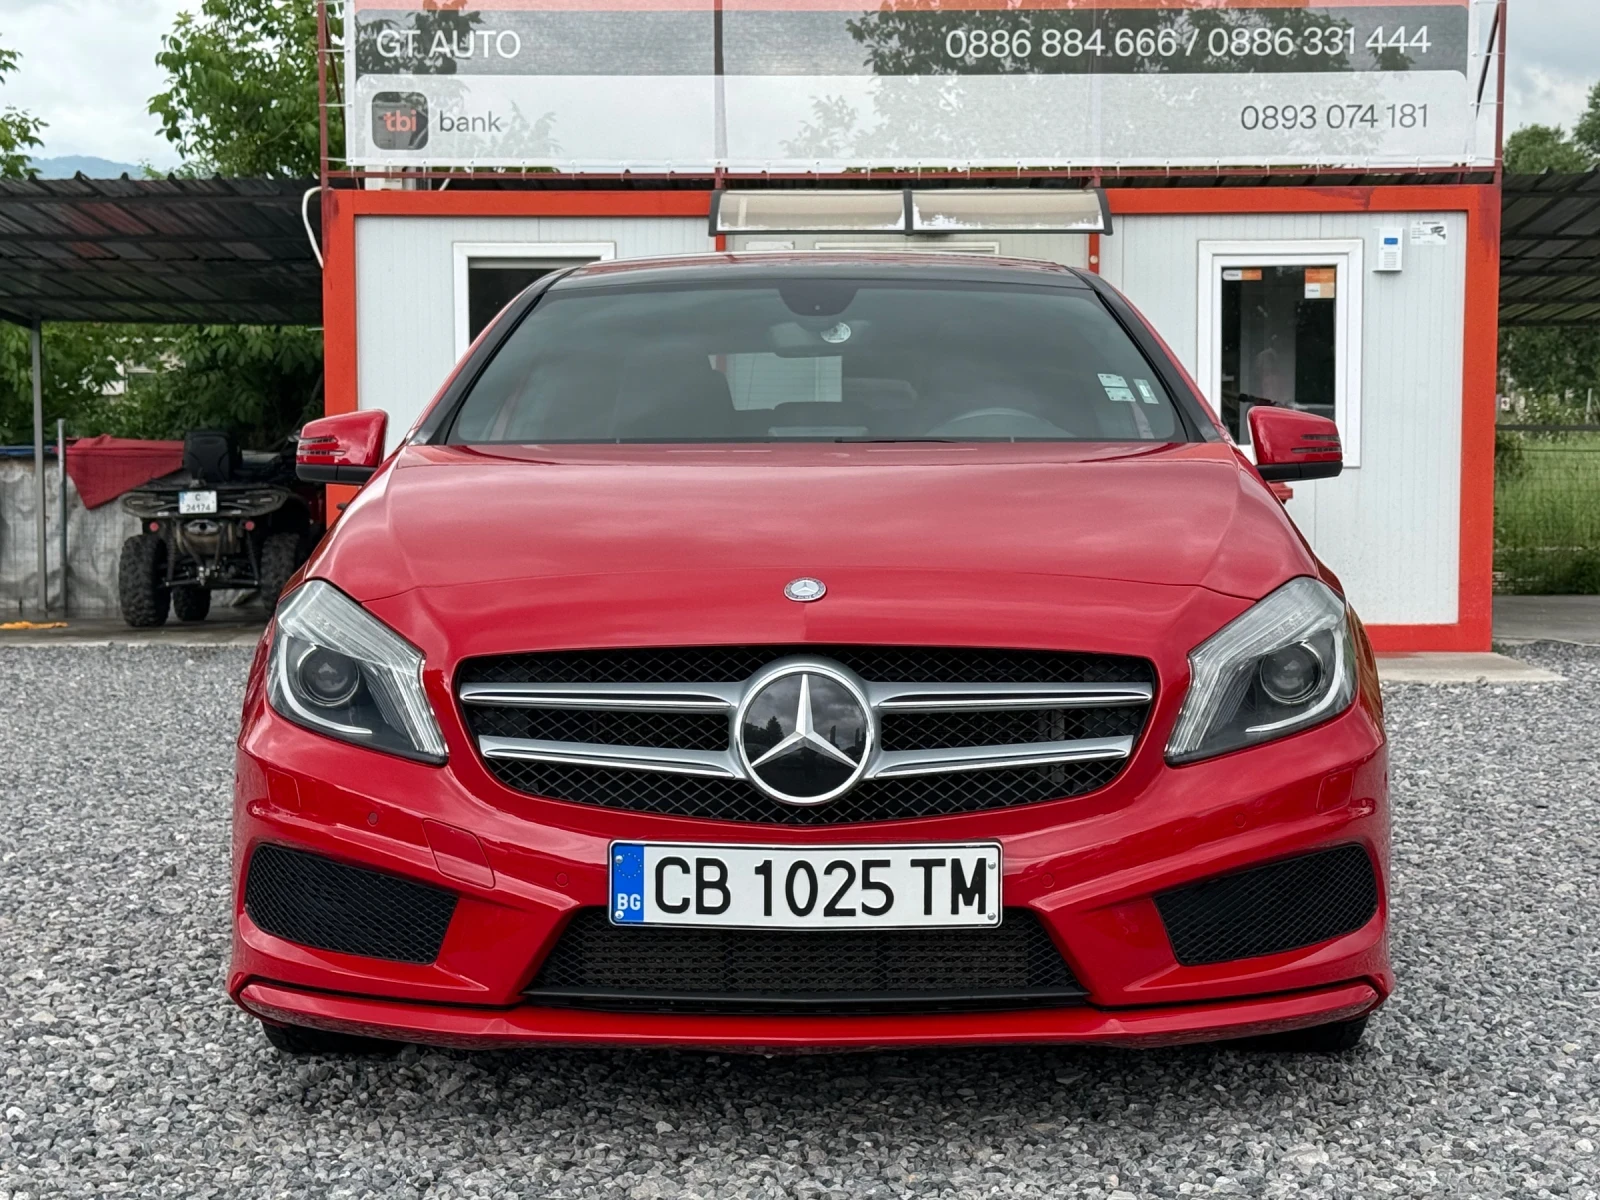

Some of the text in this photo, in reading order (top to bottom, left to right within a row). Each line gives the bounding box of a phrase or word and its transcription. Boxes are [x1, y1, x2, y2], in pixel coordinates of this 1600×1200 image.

[377, 30, 520, 59] GT AUTO
[945, 26, 1432, 58] 0886 884 666 / 0886 331 444
[384, 109, 501, 133] tbi bank
[1240, 103, 1428, 130] 0893 074 181
[655, 856, 987, 917] CB 1025 TM
[616, 893, 641, 911] BG
